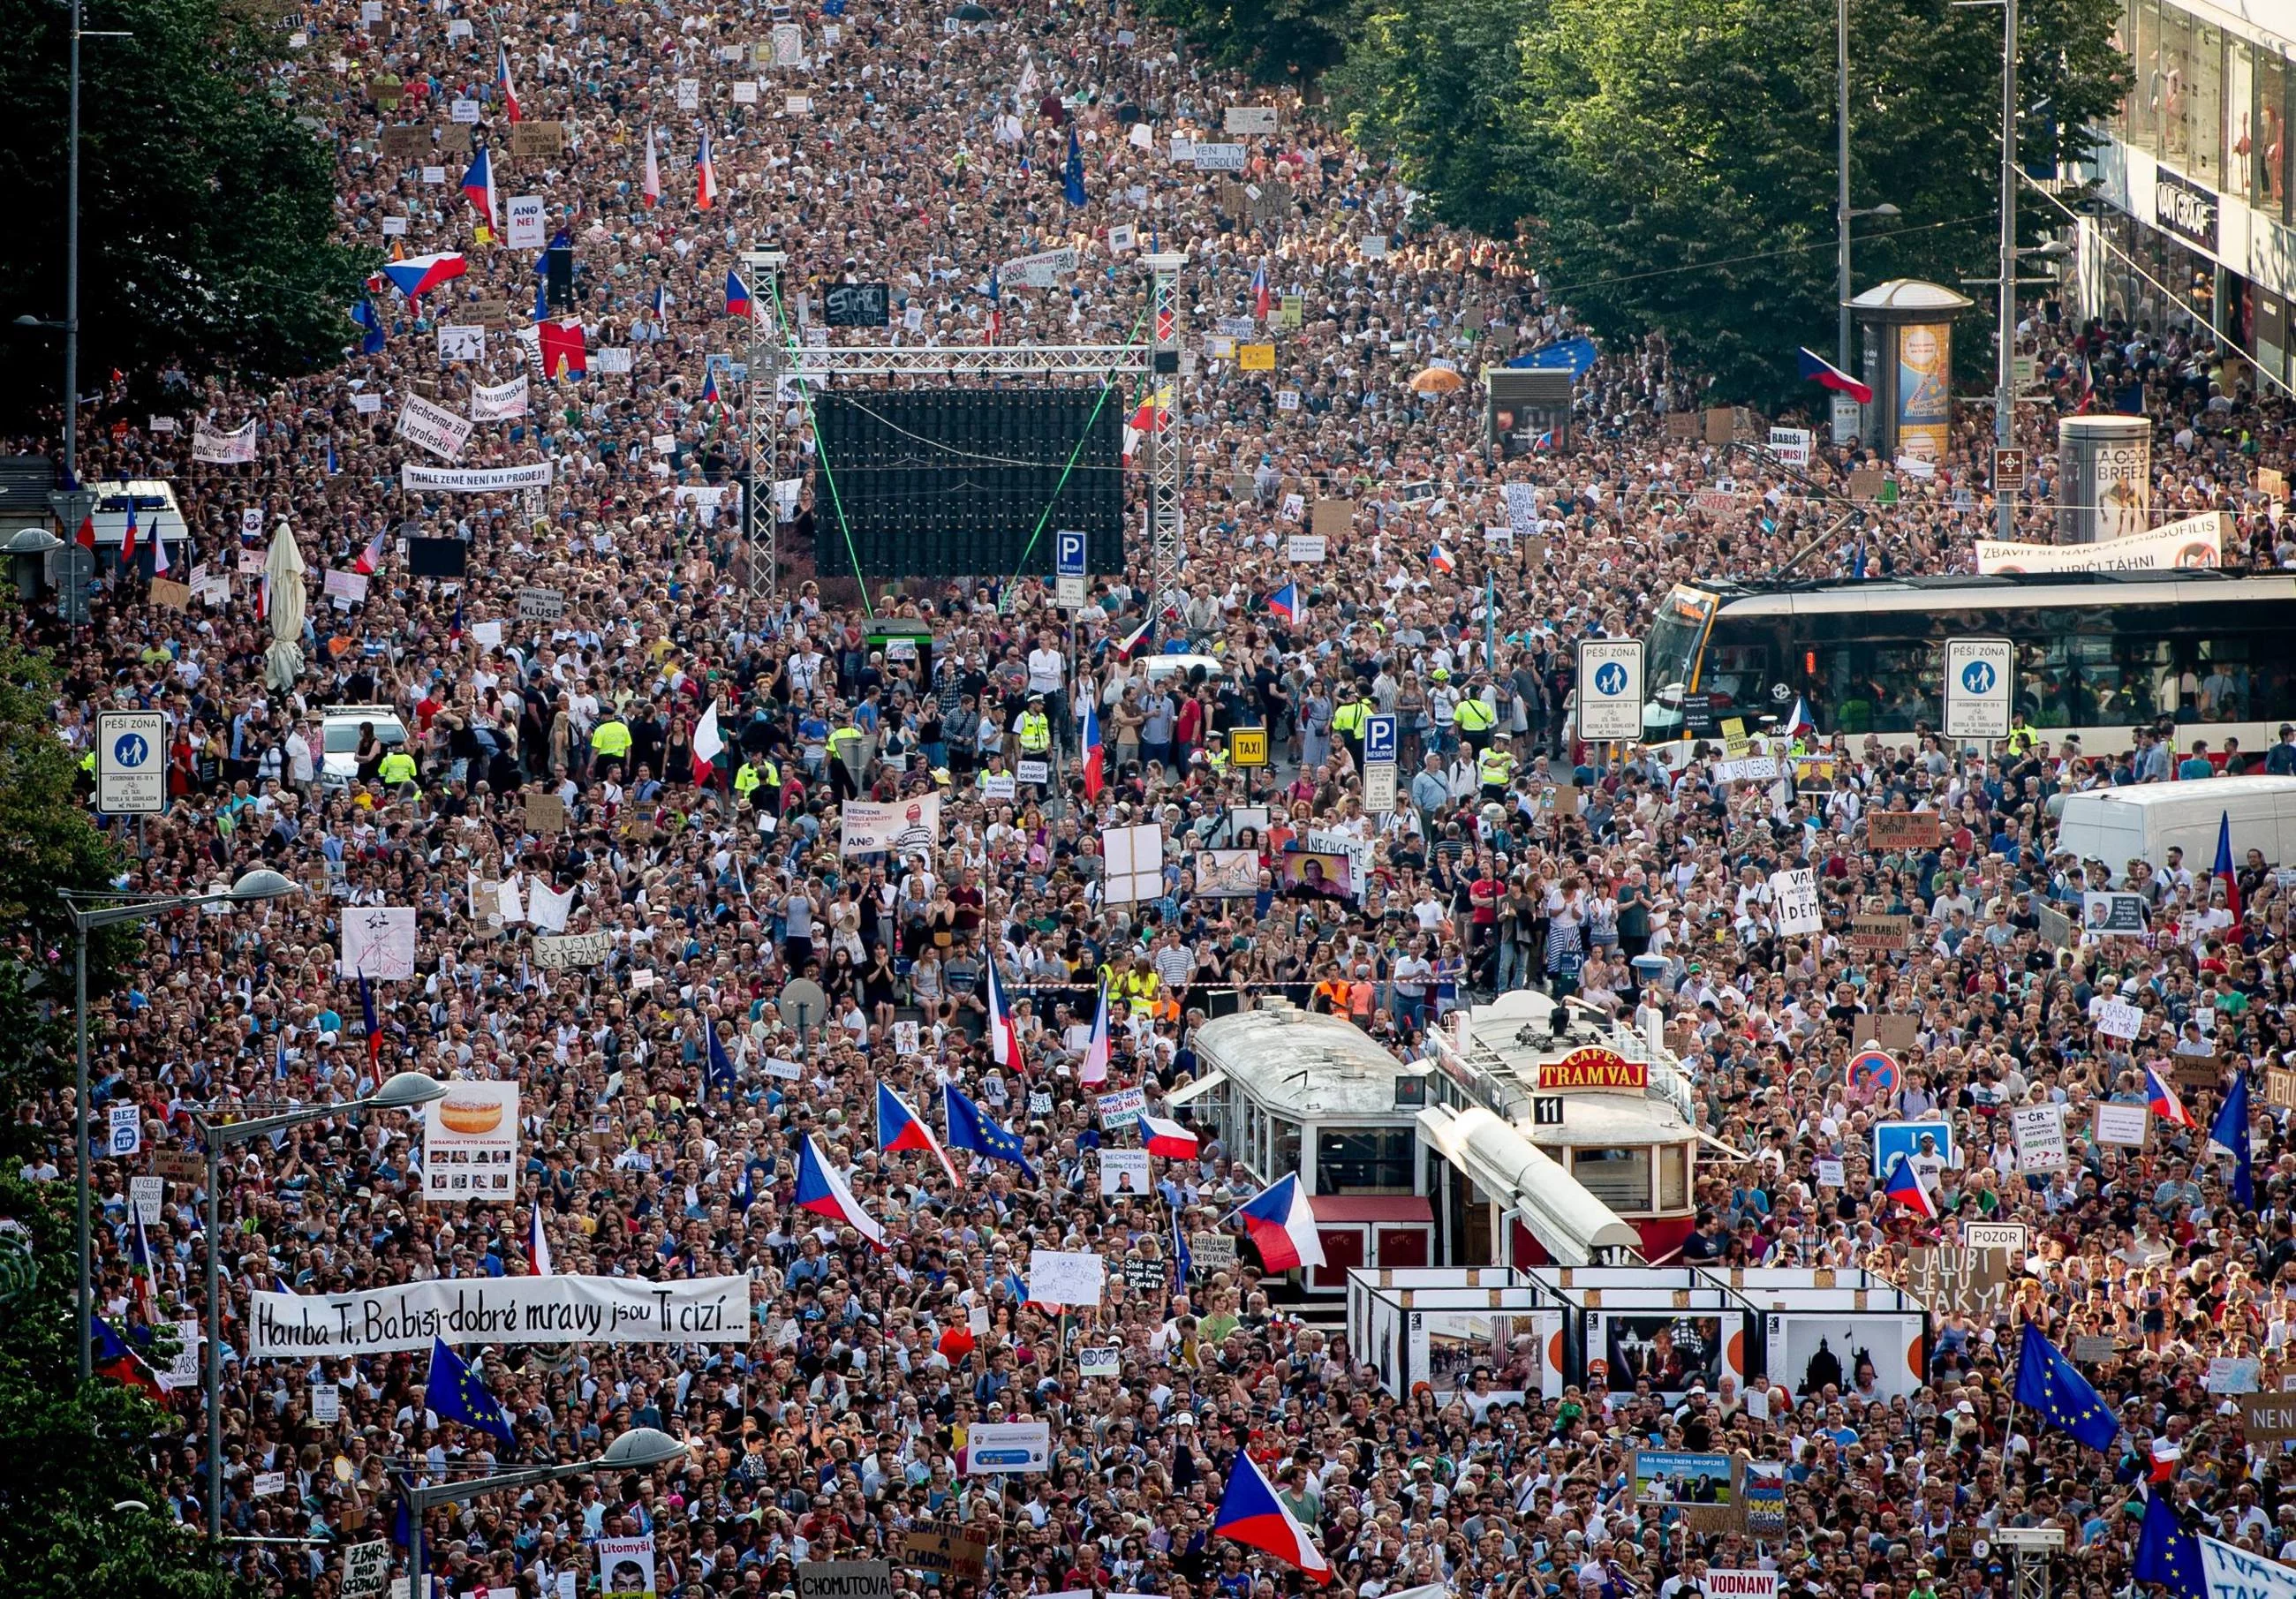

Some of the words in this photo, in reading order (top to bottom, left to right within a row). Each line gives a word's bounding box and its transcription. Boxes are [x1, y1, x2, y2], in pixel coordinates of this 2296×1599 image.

[1195, 146, 1216, 155] VEN
[1226, 146, 1244, 155] TY
[513, 206, 538, 216] ANO
[2156, 182, 2179, 221] VAN
[2175, 192, 2210, 237] GRAAF
[517, 217, 535, 227] NE!
[405, 396, 453, 430] Nechceme
[452, 421, 466, 437] žít
[1772, 432, 1801, 446] BABIŠI
[2099, 450, 2111, 464] A
[411, 471, 438, 483] TAHLE
[439, 470, 464, 483] ZEMĚ
[465, 469, 490, 484] NENÍ
[493, 472, 505, 482] NA
[508, 470, 546, 483] PRODEJ!
[1063, 538, 1080, 562] P
[1983, 547, 2033, 559] ZBAVIT
[521, 591, 544, 602] PŘIŠEL
[520, 606, 560, 618] KLUSE
[1586, 646, 1607, 660] PĚŠÍ
[1611, 645, 1636, 660] ZÓNA
[1953, 646, 1975, 659] PĚŠÍ
[1978, 645, 2005, 659] ZÓNA
[105, 716, 128, 731] PĚŠÍ
[132, 715, 157, 731] ZÓNA
[1372, 721, 1390, 749] P
[1239, 742, 1260, 754] TAXI
[848, 837, 874, 846] ANO
[1874, 923, 1902, 936] BABIŠ
[540, 939, 549, 953] S
[542, 955, 557, 968] SE
[1541, 1066, 1644, 1088] TRAMVAJ
[114, 1110, 136, 1120] BEZ
[1540, 1101, 1558, 1122] 11
[2028, 1113, 2045, 1122] ČR
[1974, 1231, 2017, 1242] POZOR
[1126, 1260, 1144, 1269] Stát
[259, 1302, 331, 1347] Hanba
[331, 1302, 360, 1346] Ti,
[526, 1301, 601, 1336] mravy
[610, 1301, 652, 1332] jsou
[652, 1290, 674, 1331] Ti
[351, 1546, 384, 1565] ŽĎÁR
[602, 1543, 652, 1555] Litomyšl
[353, 1566, 376, 1577] NAD
[802, 1575, 890, 1596] CHOMUTOVA
[1710, 1572, 1774, 1595] VODŇANY
